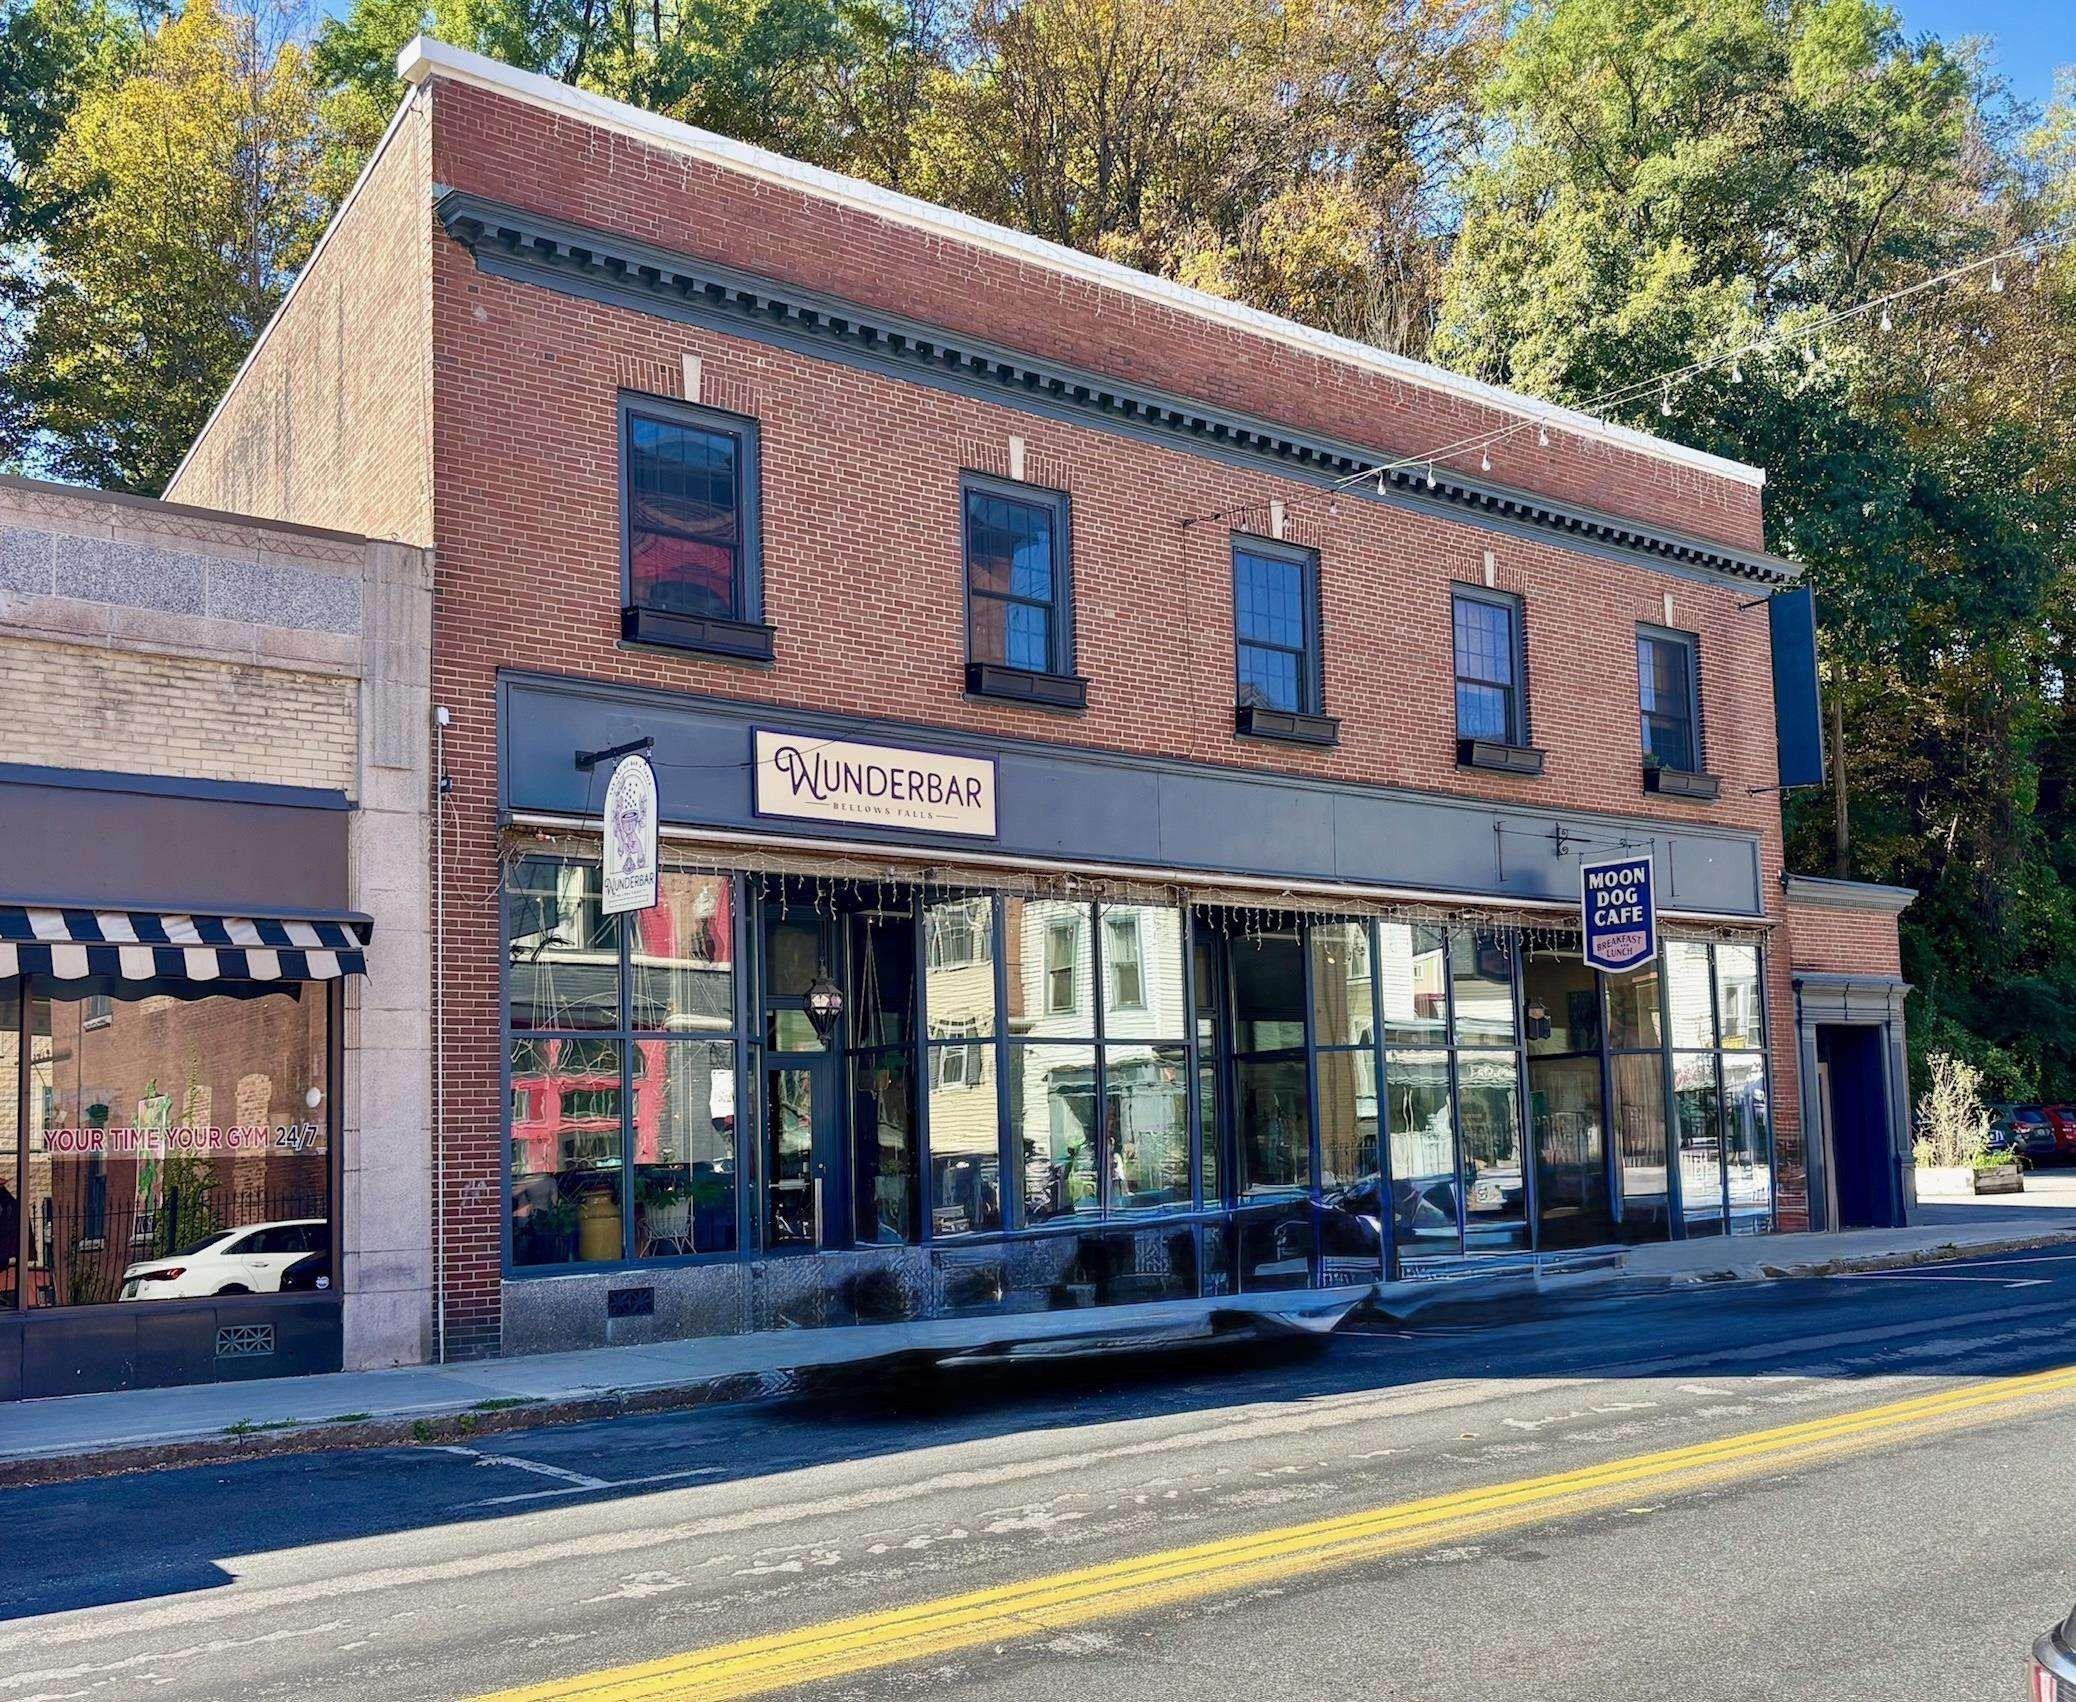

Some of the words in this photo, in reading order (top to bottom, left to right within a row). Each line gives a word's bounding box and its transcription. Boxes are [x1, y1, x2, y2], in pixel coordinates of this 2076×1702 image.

[774, 746, 982, 808] WUNDERBAR
[833, 802, 891, 815] BELLOWS
[897, 808, 933, 820] FALLS
[604, 872, 655, 896] WUNDERBAR
[1588, 867, 1645, 889] MOON
[1596, 887, 1637, 907] DOG
[1594, 906, 1643, 927] CAFE
[1596, 935, 1641, 951] BREAKFAST
[1606, 947, 1633, 958] LUNCH
[44, 1128, 105, 1152] YOUR
[109, 1127, 161, 1151] TIME
[164, 1126, 221, 1150] YOUR
[227, 1125, 269, 1149] GYM
[275, 1124, 320, 1151] 24/7
